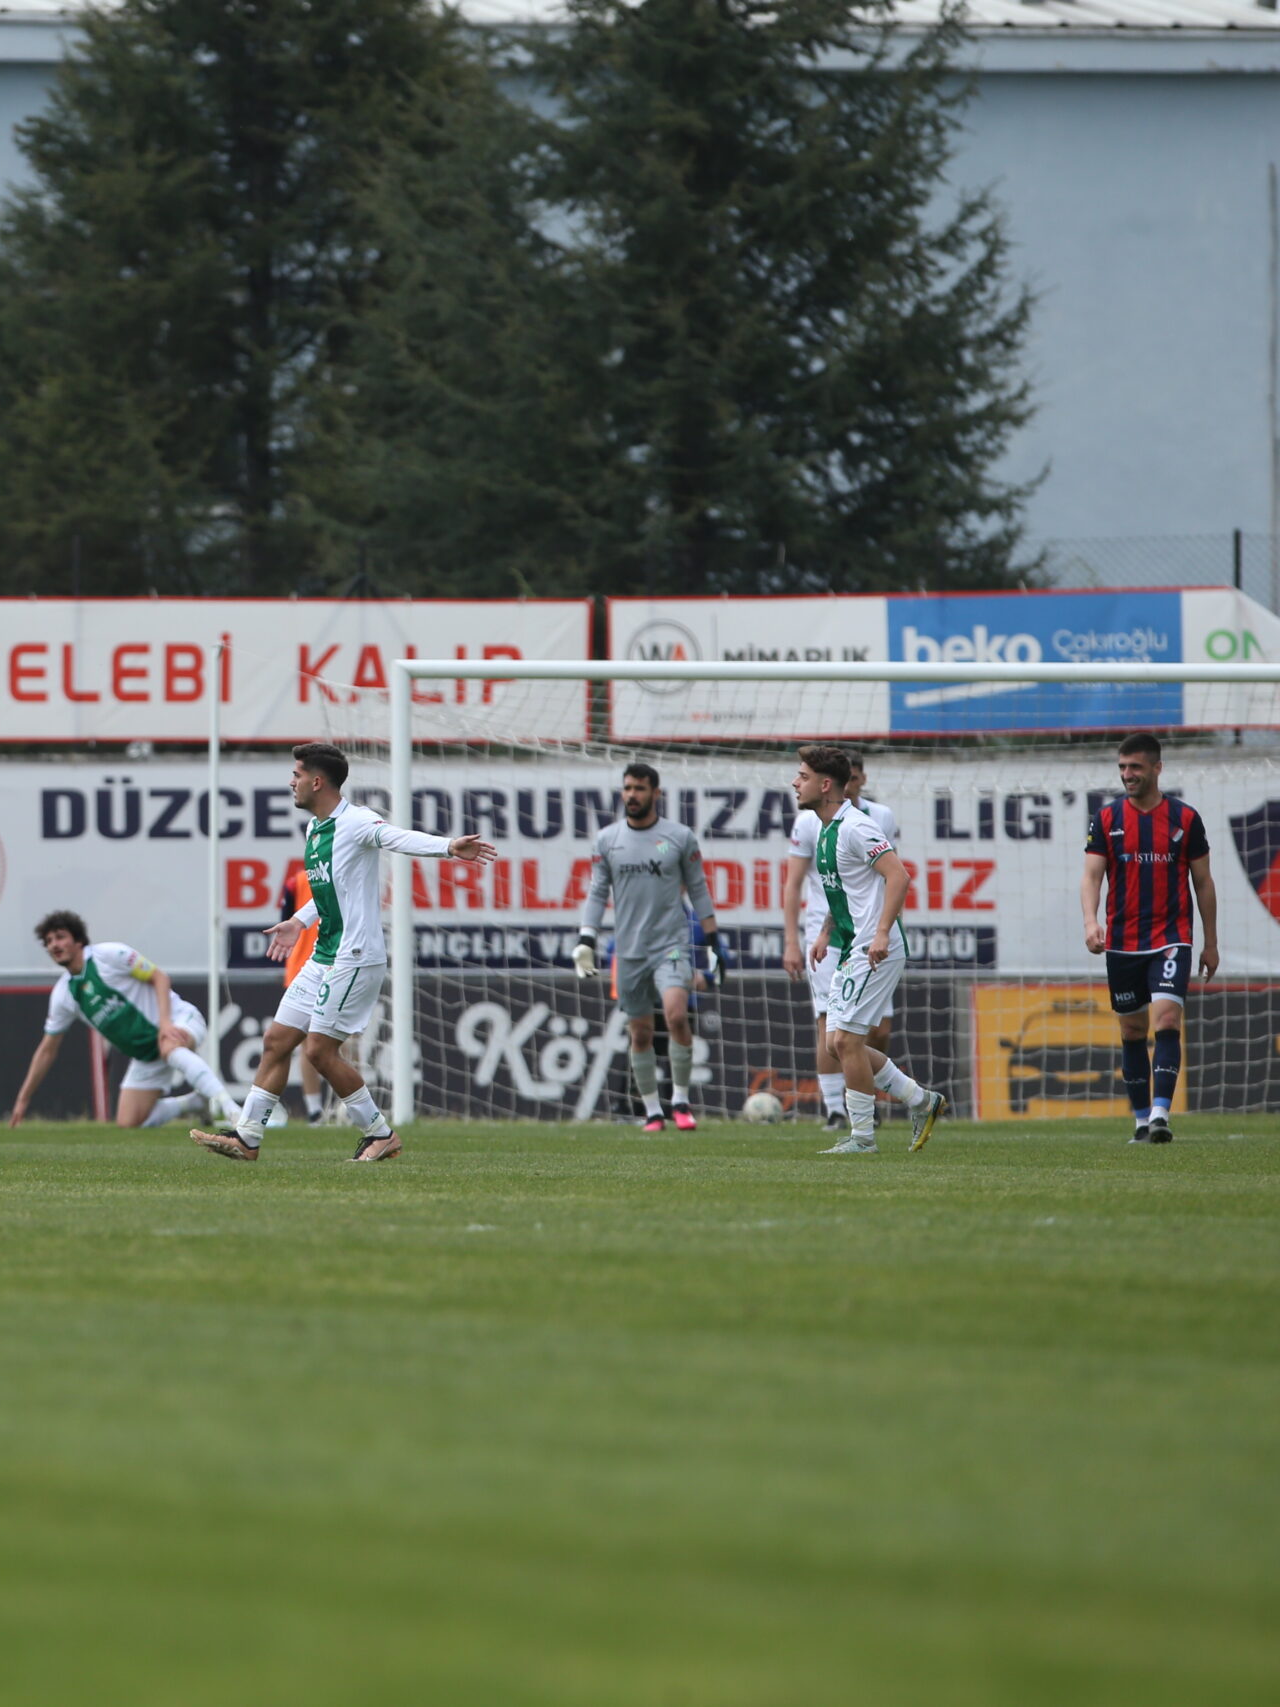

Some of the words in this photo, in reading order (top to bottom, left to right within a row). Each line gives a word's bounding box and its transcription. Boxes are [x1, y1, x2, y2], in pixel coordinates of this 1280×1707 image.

[902, 625, 1042, 662] beko
[299, 643, 524, 704] KALIP
[1162, 959, 1177, 979] 9
[316, 983, 331, 1007] 9
